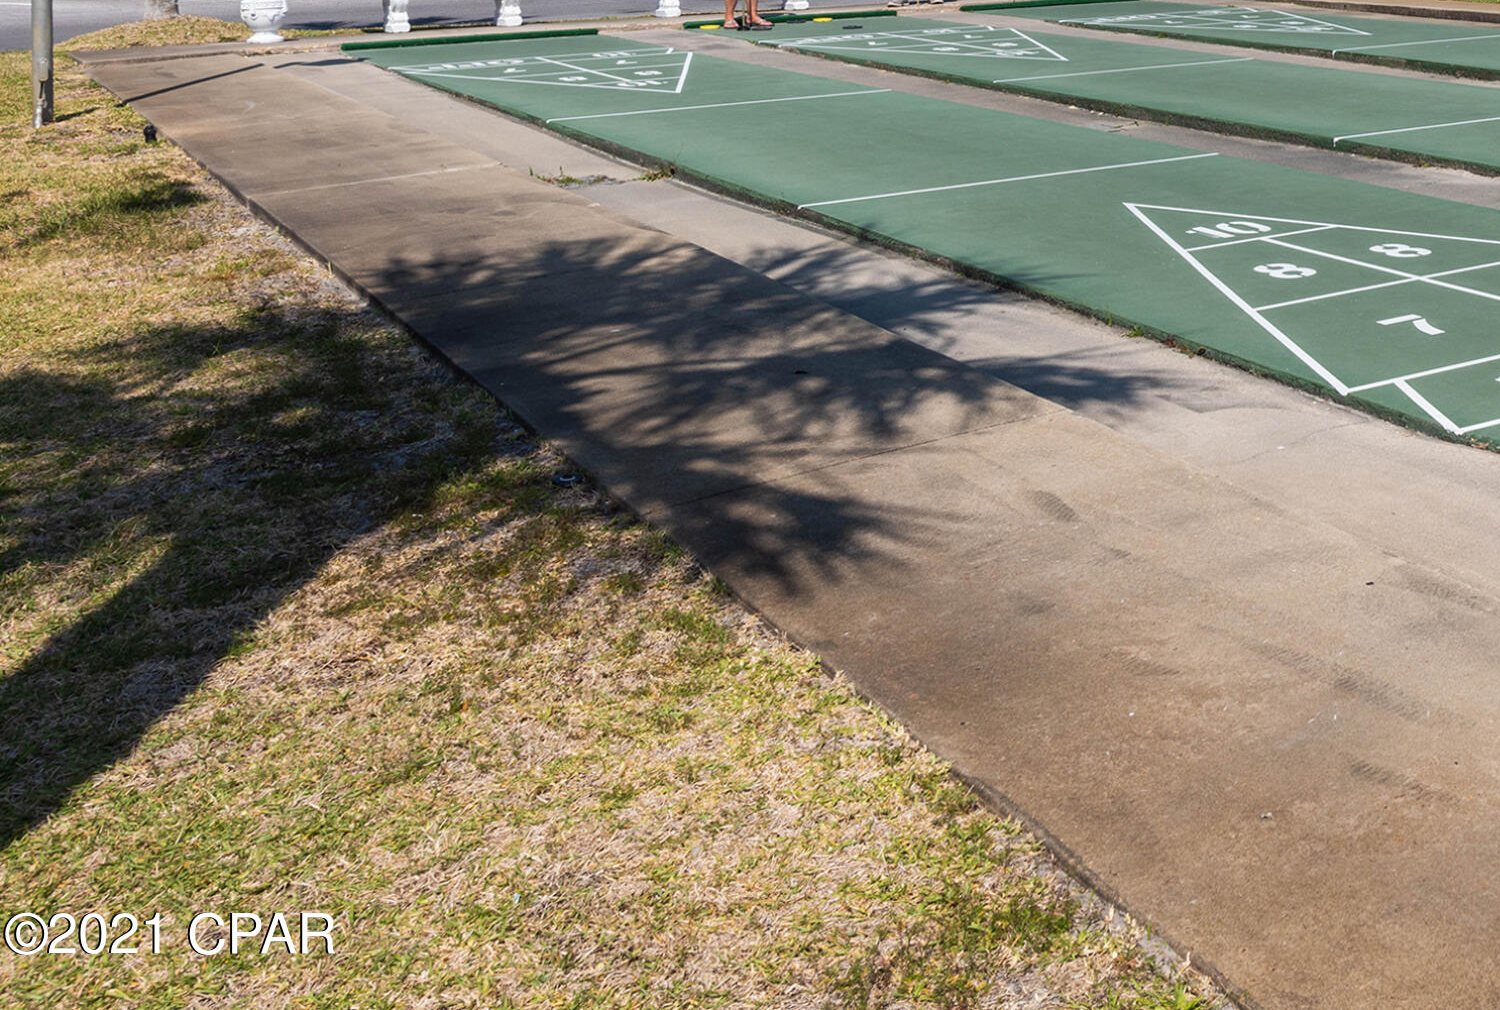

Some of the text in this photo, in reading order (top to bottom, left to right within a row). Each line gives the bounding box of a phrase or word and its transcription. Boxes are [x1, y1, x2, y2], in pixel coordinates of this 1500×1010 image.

[1185, 221, 1272, 239] 10
[1368, 243, 1433, 258] 8
[1253, 262, 1317, 280] 8
[1375, 313, 1446, 336] 7
